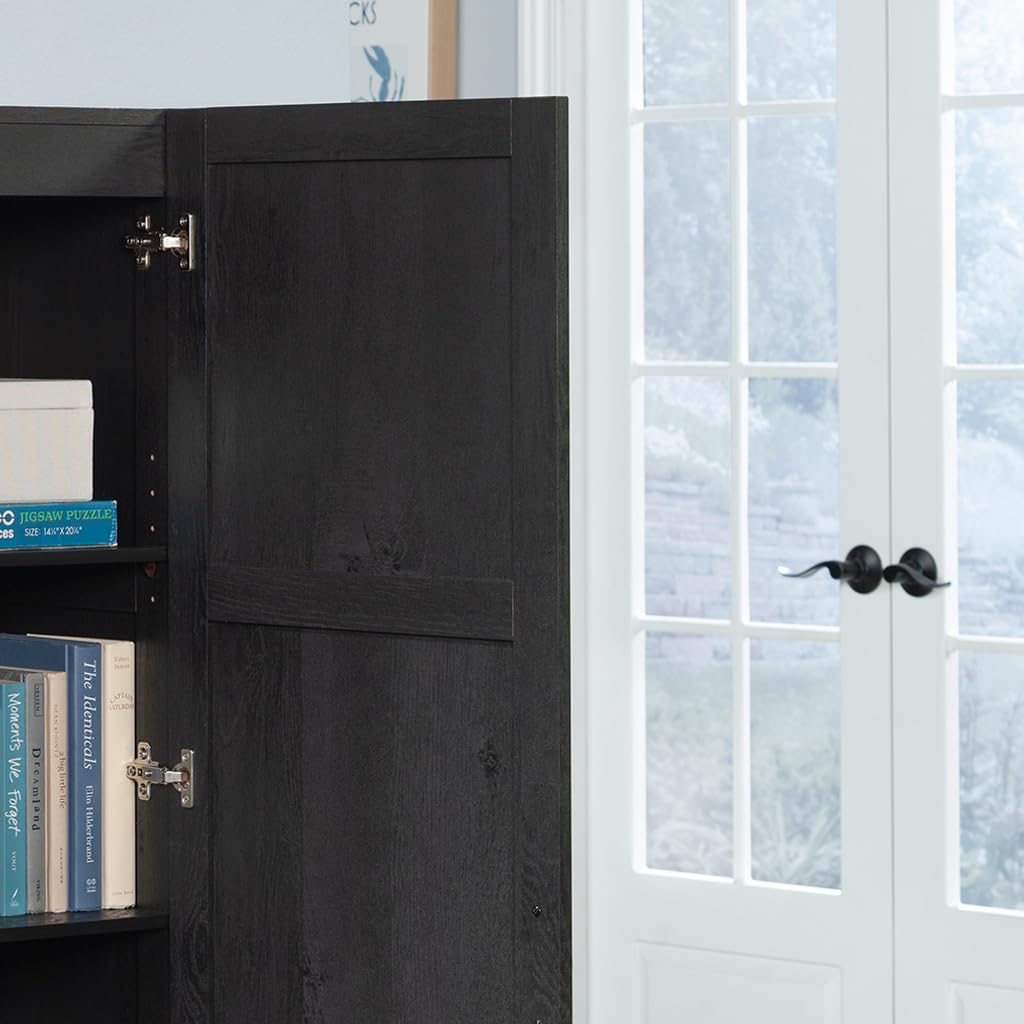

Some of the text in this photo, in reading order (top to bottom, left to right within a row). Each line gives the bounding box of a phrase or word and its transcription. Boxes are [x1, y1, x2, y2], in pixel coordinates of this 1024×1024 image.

[19, 508, 113, 525] JIGSAW PUZZLE
[24, 527, 41, 537] SIZE:
[83, 660, 97, 770] The Identicals
[4, 692, 24, 838] Moments We Forget
[85, 785, 95, 863] Elin Hilderbrand
